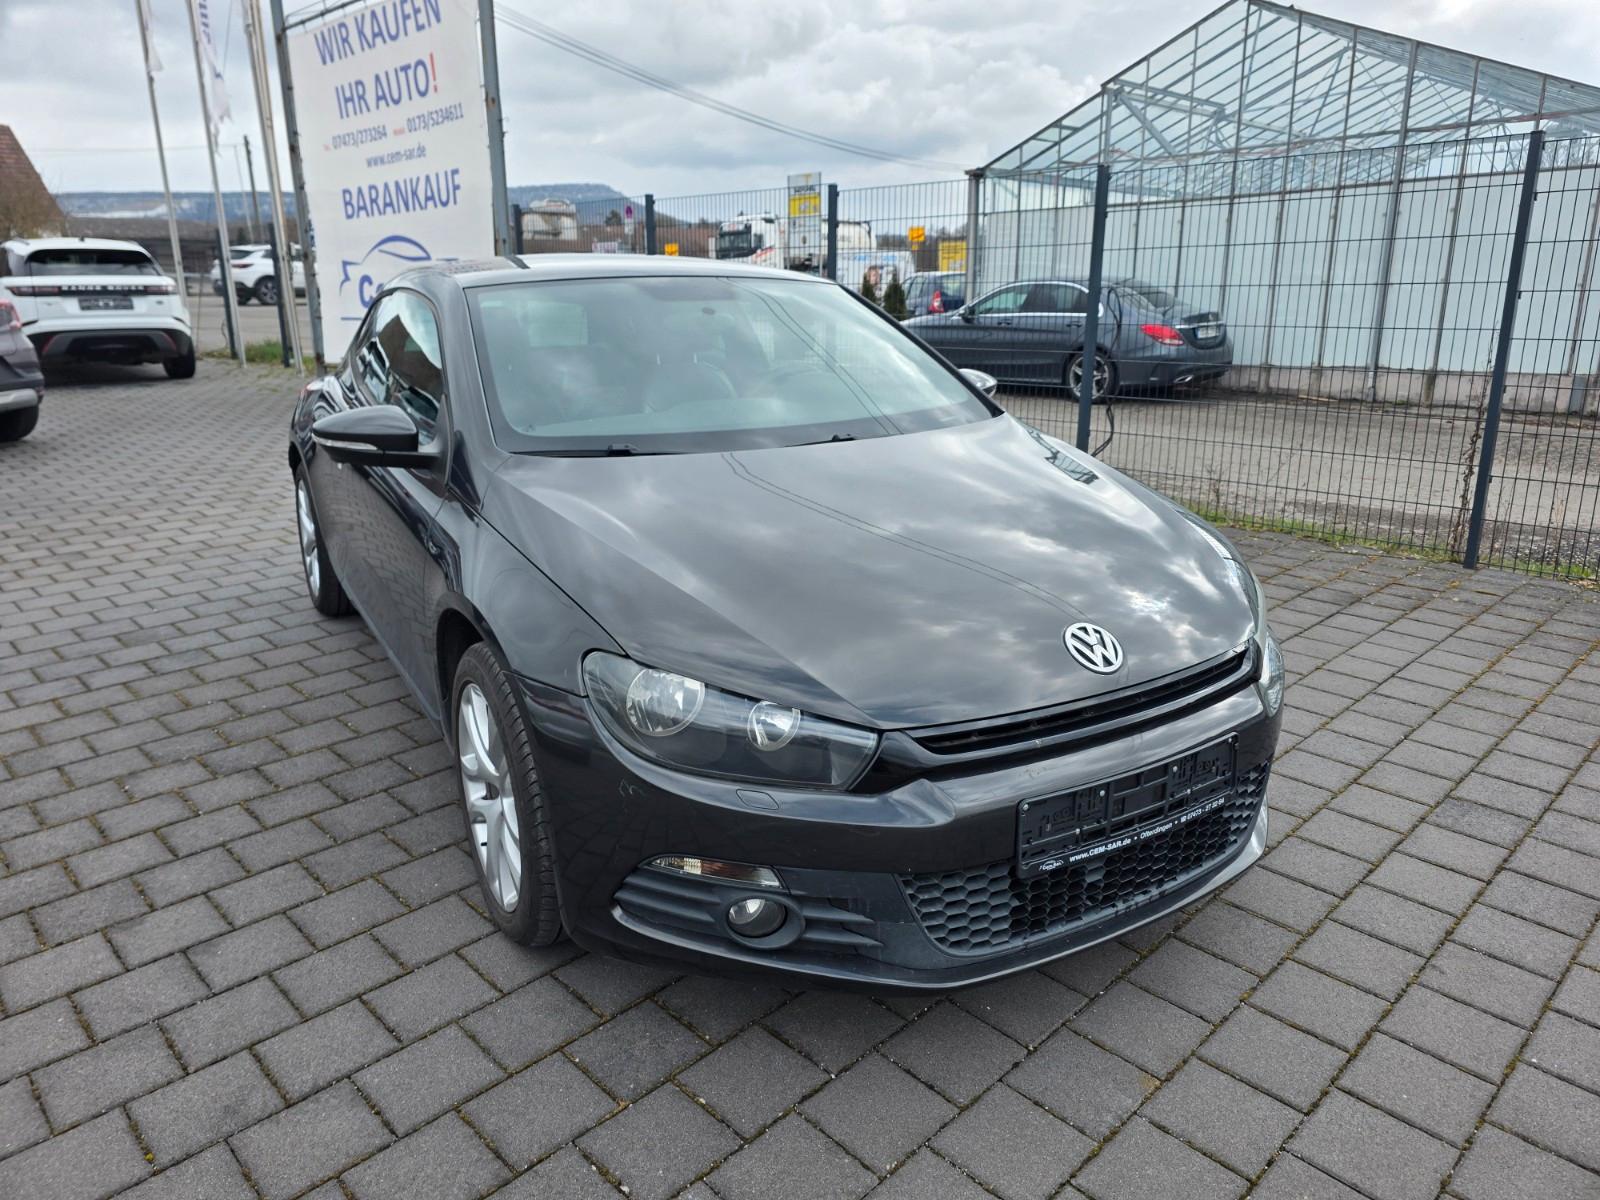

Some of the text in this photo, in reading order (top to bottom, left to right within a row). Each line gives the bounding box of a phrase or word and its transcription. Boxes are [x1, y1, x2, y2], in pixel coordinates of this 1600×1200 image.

[313, 0, 441, 66] WIR KAUFEN
[335, 52, 438, 119] IHR AUTO!
[341, 168, 461, 220] BARANKAUF
